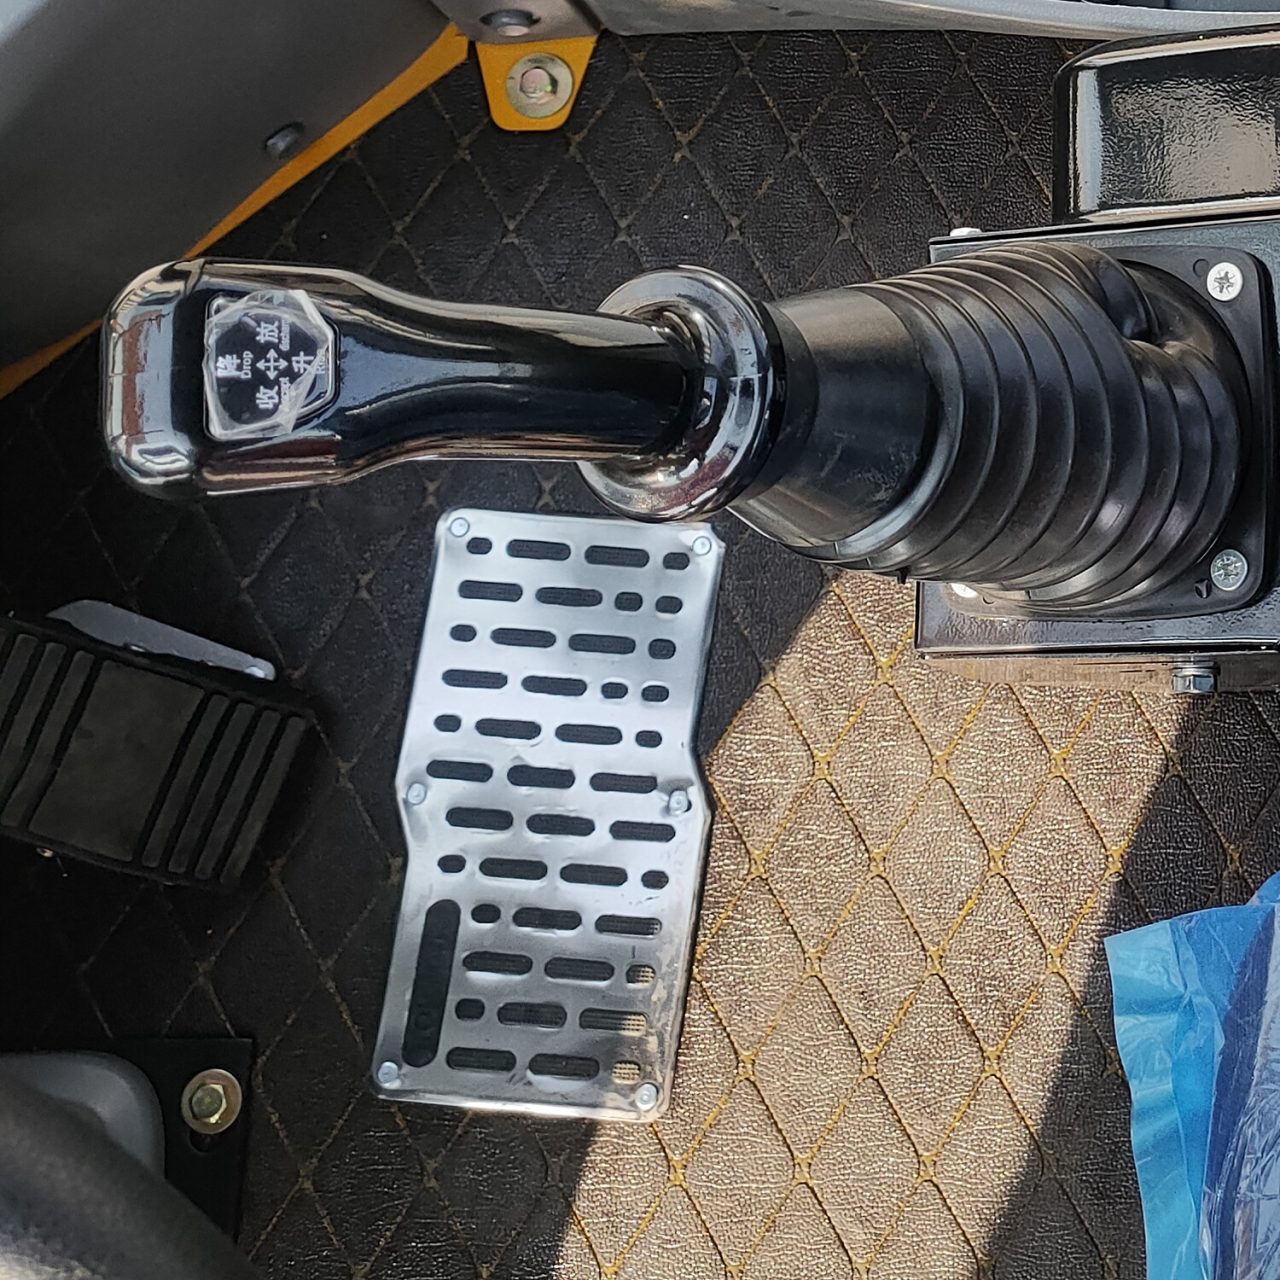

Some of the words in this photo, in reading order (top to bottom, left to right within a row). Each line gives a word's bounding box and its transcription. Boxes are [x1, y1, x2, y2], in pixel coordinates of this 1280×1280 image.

[256, 321, 279, 343] 放
[216, 354, 241, 378] 降
[241, 351, 253, 379] Drop
[291, 351, 314, 373] 升
[256, 385, 279, 409] 收
